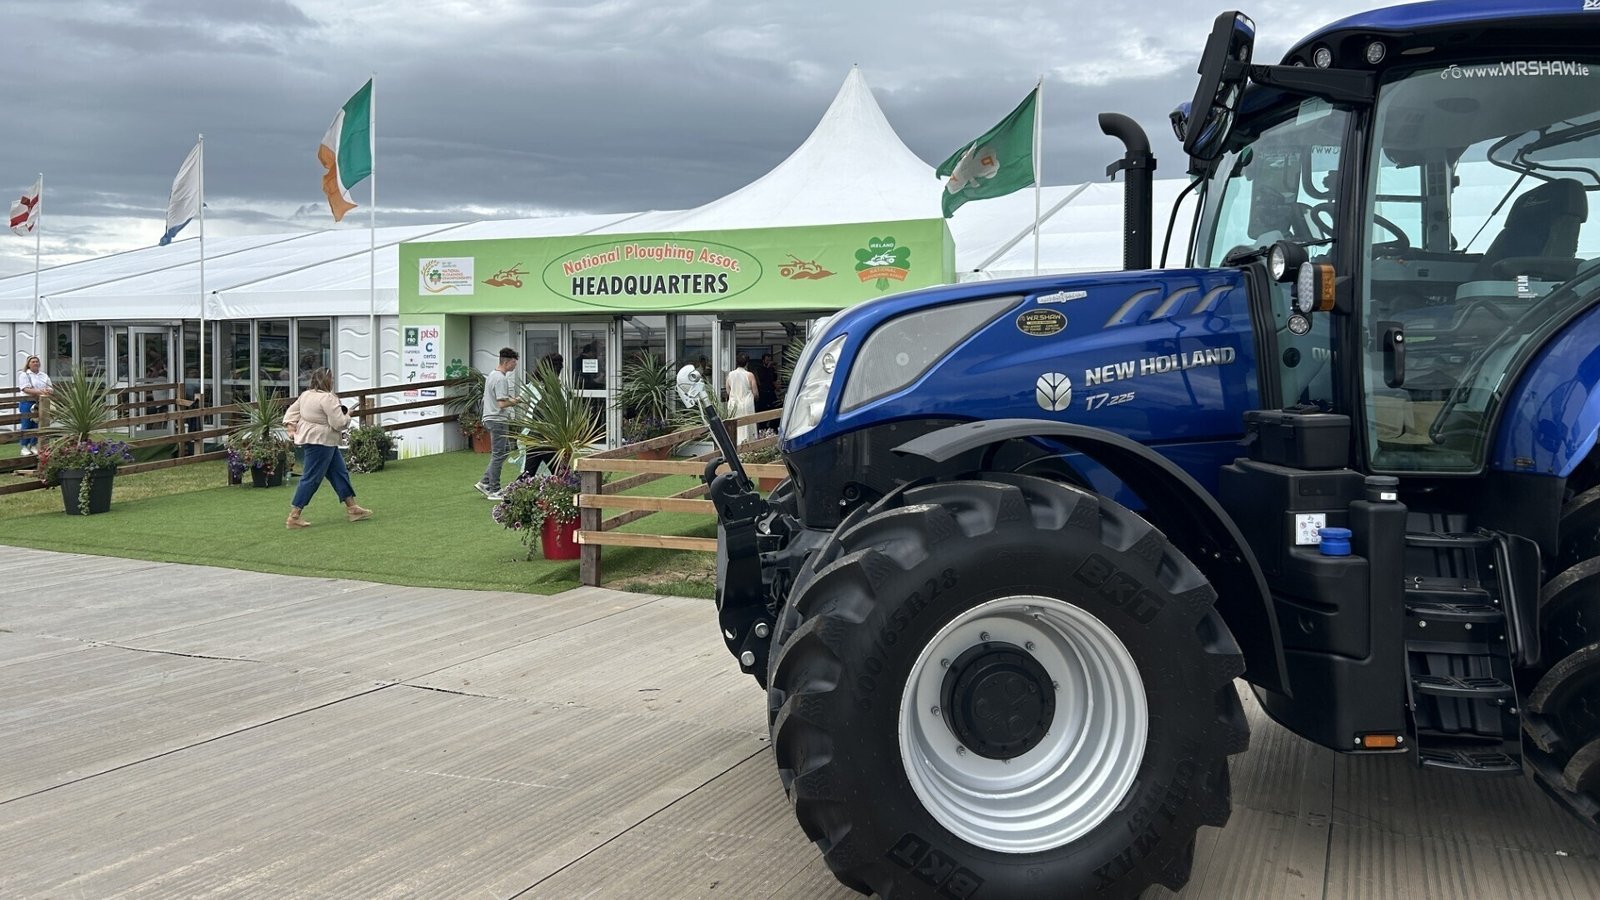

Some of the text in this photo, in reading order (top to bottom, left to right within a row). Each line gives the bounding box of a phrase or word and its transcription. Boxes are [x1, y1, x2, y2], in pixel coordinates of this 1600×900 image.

[1463, 60, 1590, 78] www.WRSHAW.ie
[563, 243, 740, 275] National Ploughing Assoc.
[572, 273, 728, 296] HEADQUARTERS
[420, 328, 439, 341] ptsb
[1085, 347, 1236, 387] NEW HOLLAND
[1085, 391, 1136, 411] T7.225
[1074, 554, 1165, 622] BKT
[886, 833, 985, 900] BKT
